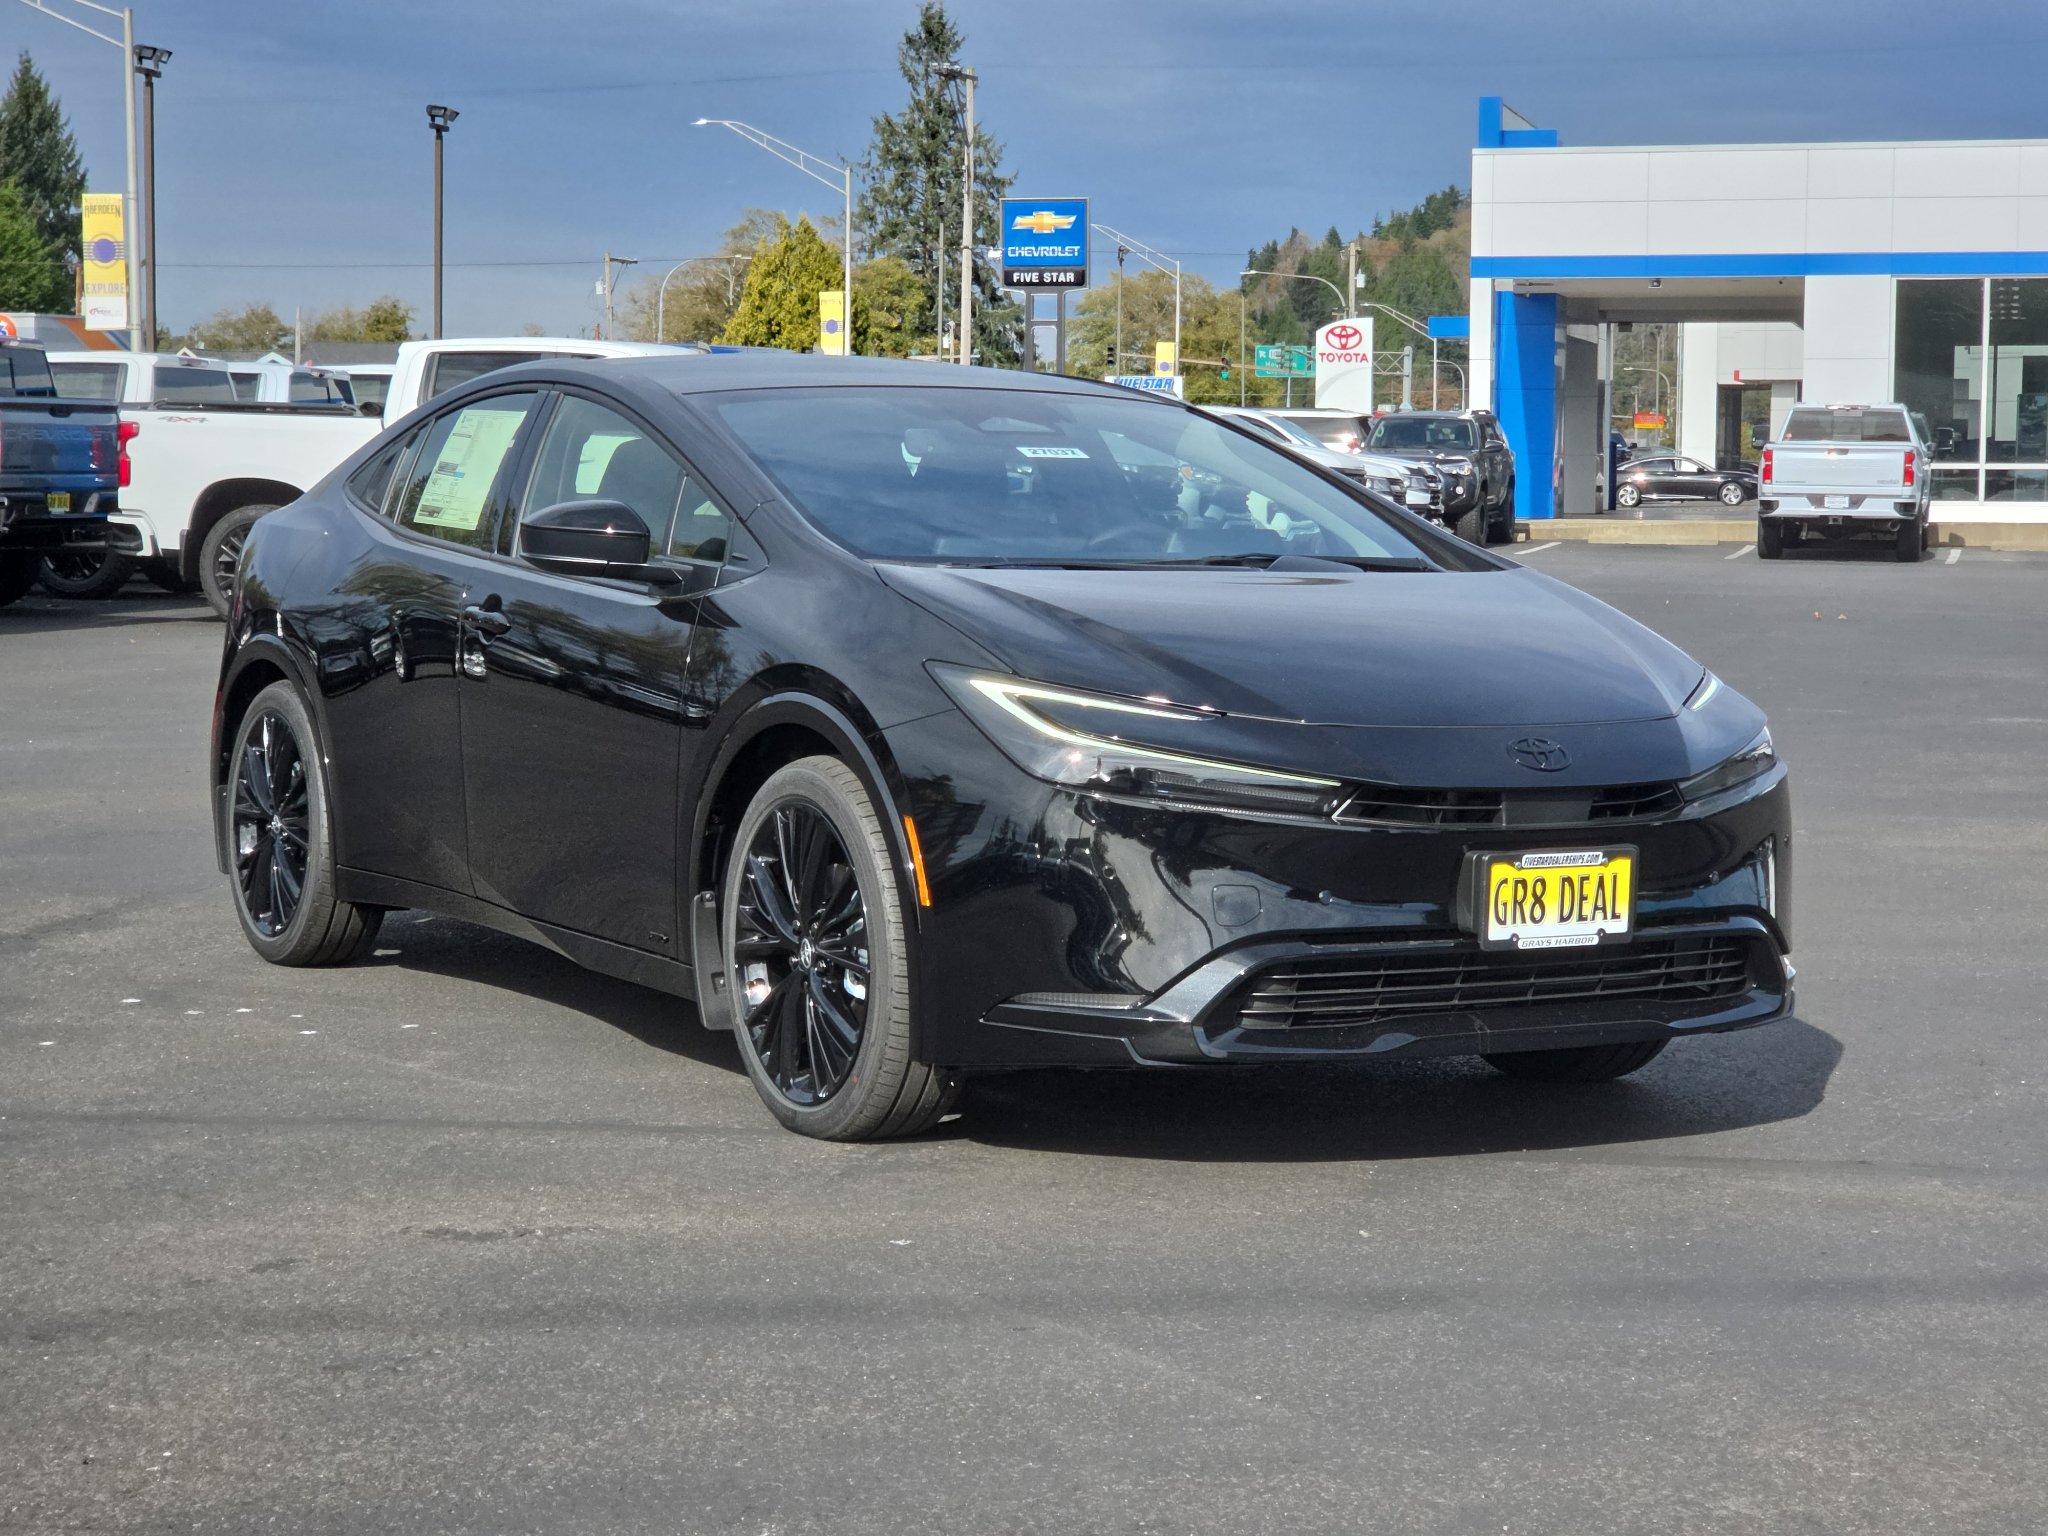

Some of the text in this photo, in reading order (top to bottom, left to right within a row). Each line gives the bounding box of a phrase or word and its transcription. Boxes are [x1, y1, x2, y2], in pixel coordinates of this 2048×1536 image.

[85, 204, 121, 218] ABERDEEN
[1007, 245, 1081, 257] CHEVROLET
[1013, 272, 1075, 283] FIVE STAR
[86, 282, 125, 295] EXPLORE
[1318, 352, 1370, 363] TOYOTA
[1142, 378, 1174, 390] STAR
[1523, 853, 1602, 867] FIVESTARDEALERSHIPS.COM
[1493, 872, 1622, 926] GR8 DEAL
[1521, 936, 1595, 948] GRAYS HARBOR
